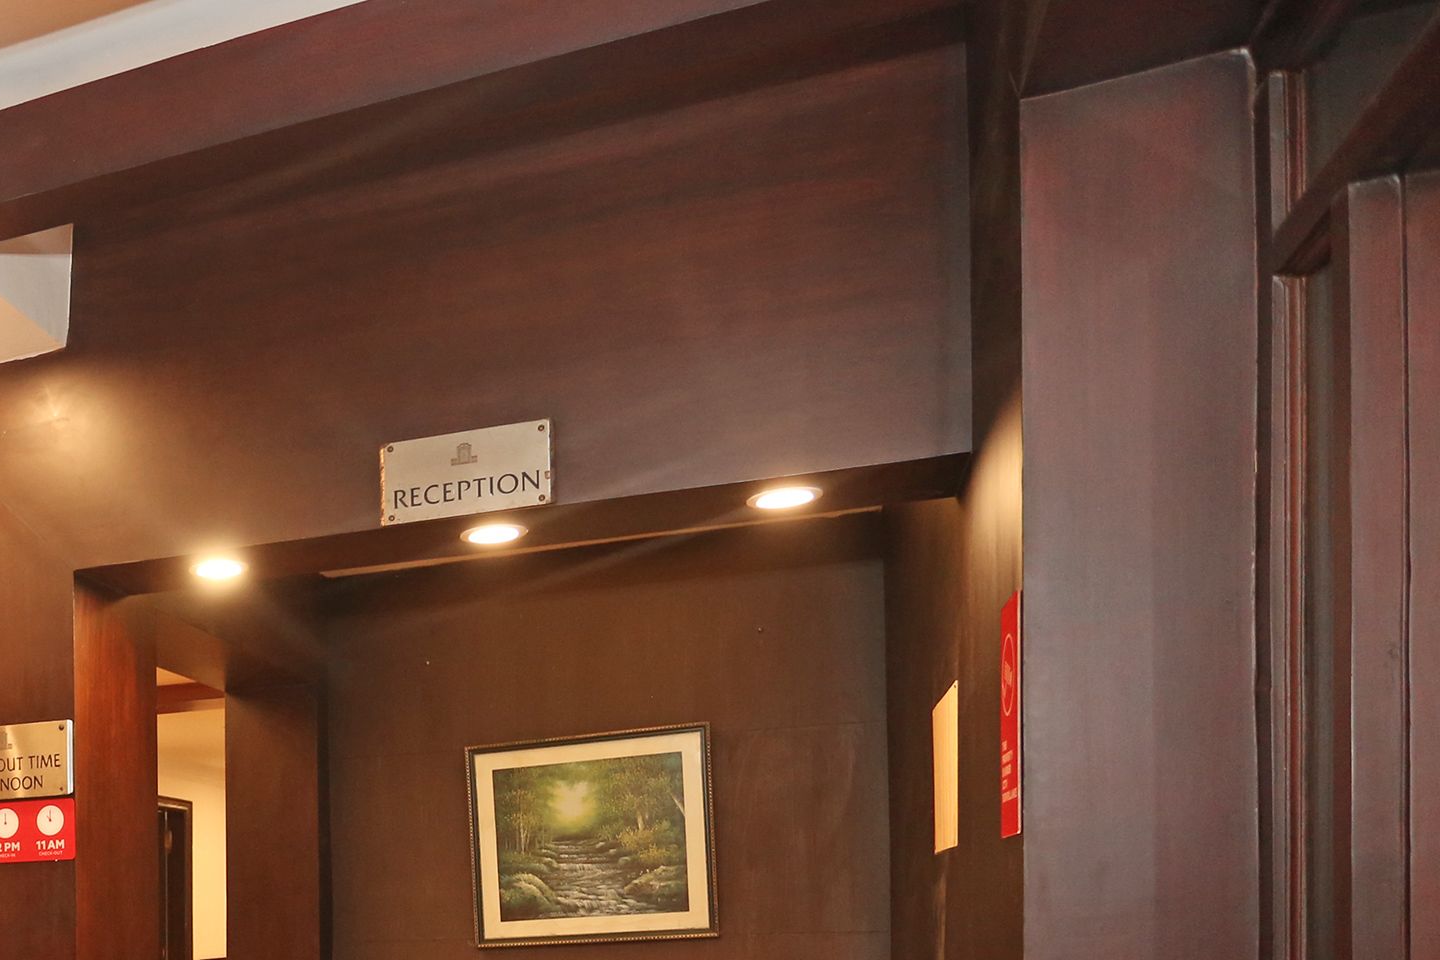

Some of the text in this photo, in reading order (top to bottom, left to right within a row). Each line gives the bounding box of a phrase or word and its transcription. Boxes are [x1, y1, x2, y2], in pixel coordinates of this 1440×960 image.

[393, 469, 540, 509] RECEPTION
[28, 753, 62, 770] TIME
[0, 775, 44, 791] NOON
[4, 841, 20, 852] PM
[35, 839, 65, 850] 11 AM
